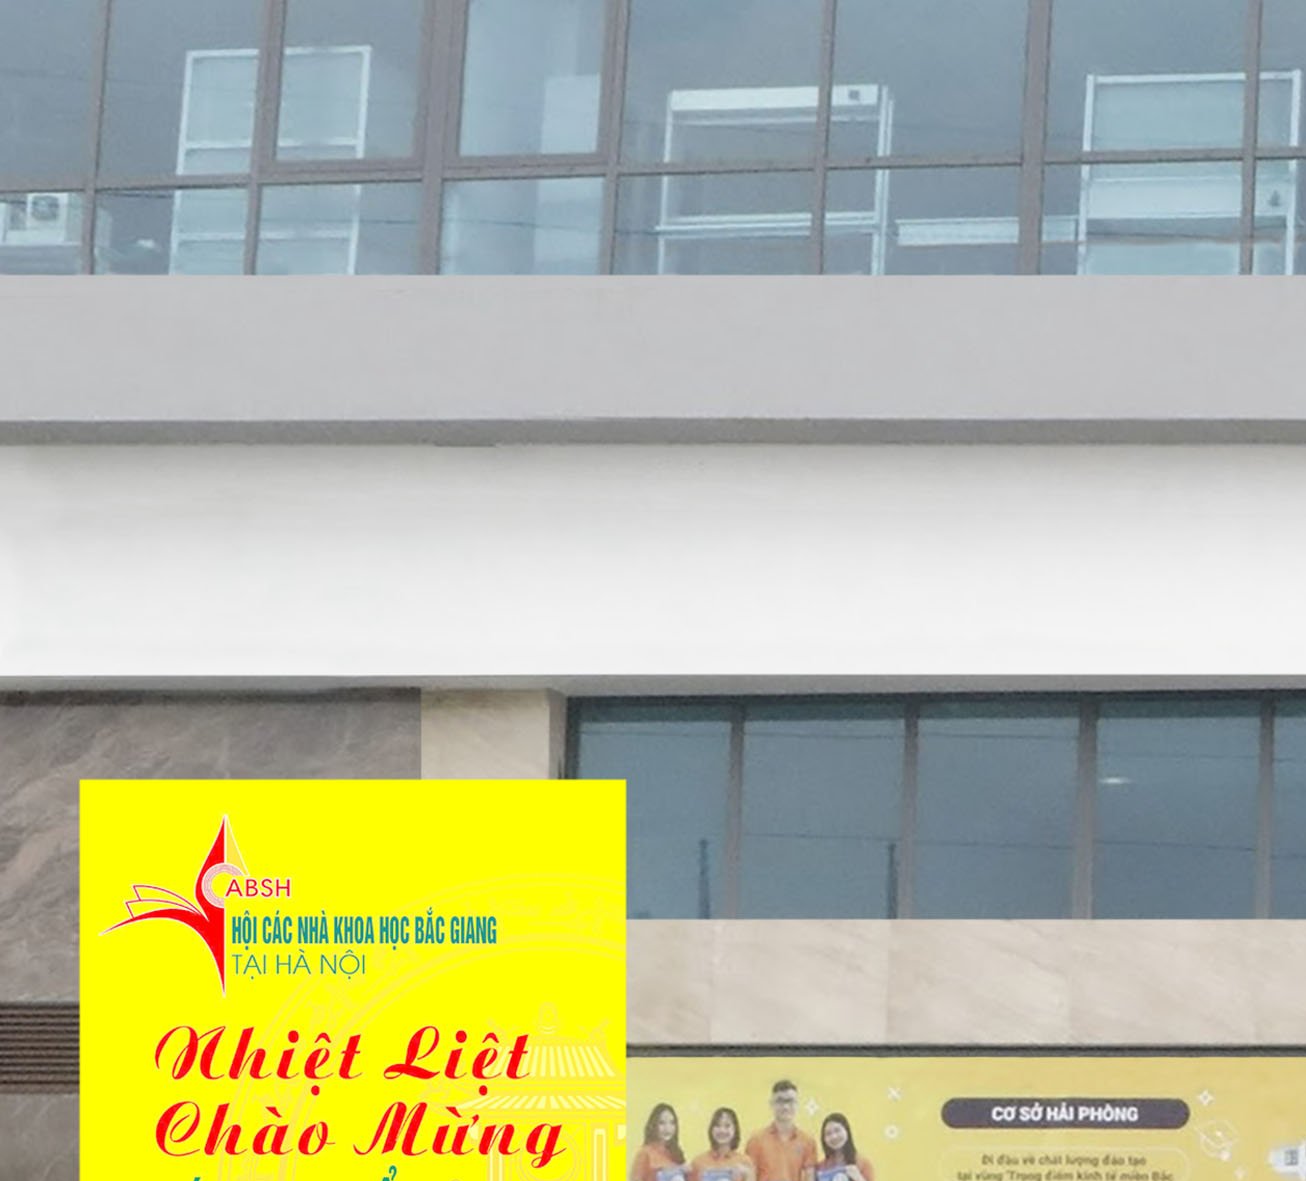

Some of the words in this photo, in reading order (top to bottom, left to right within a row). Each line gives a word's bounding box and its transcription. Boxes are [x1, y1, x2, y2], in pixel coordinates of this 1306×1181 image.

[231, 910, 258, 951] HỘI
[262, 910, 293, 945] CÁC
[298, 910, 329, 945] NHÀ
[333, 915, 375, 945] KHOA
[379, 915, 410, 951] HỌC
[414, 907, 445, 945] BẮC
[450, 915, 497, 945] GIANG
[231, 954, 267, 980] TẠI
[275, 948, 312, 975] HÀ
[319, 949, 366, 980] NỘI
[154, 1025, 362, 1096] Nhiệt
[383, 1025, 530, 1096] Liệt
[991, 1105, 1017, 1122] CƠ
[1019, 1102, 1044, 1122] SỞ
[1046, 1102, 1074, 1121] HẢI
[1078, 1103, 1139, 1122] PHÒNG
[155, 1100, 335, 1158] Chào
[353, 1100, 567, 1169] Mừng
